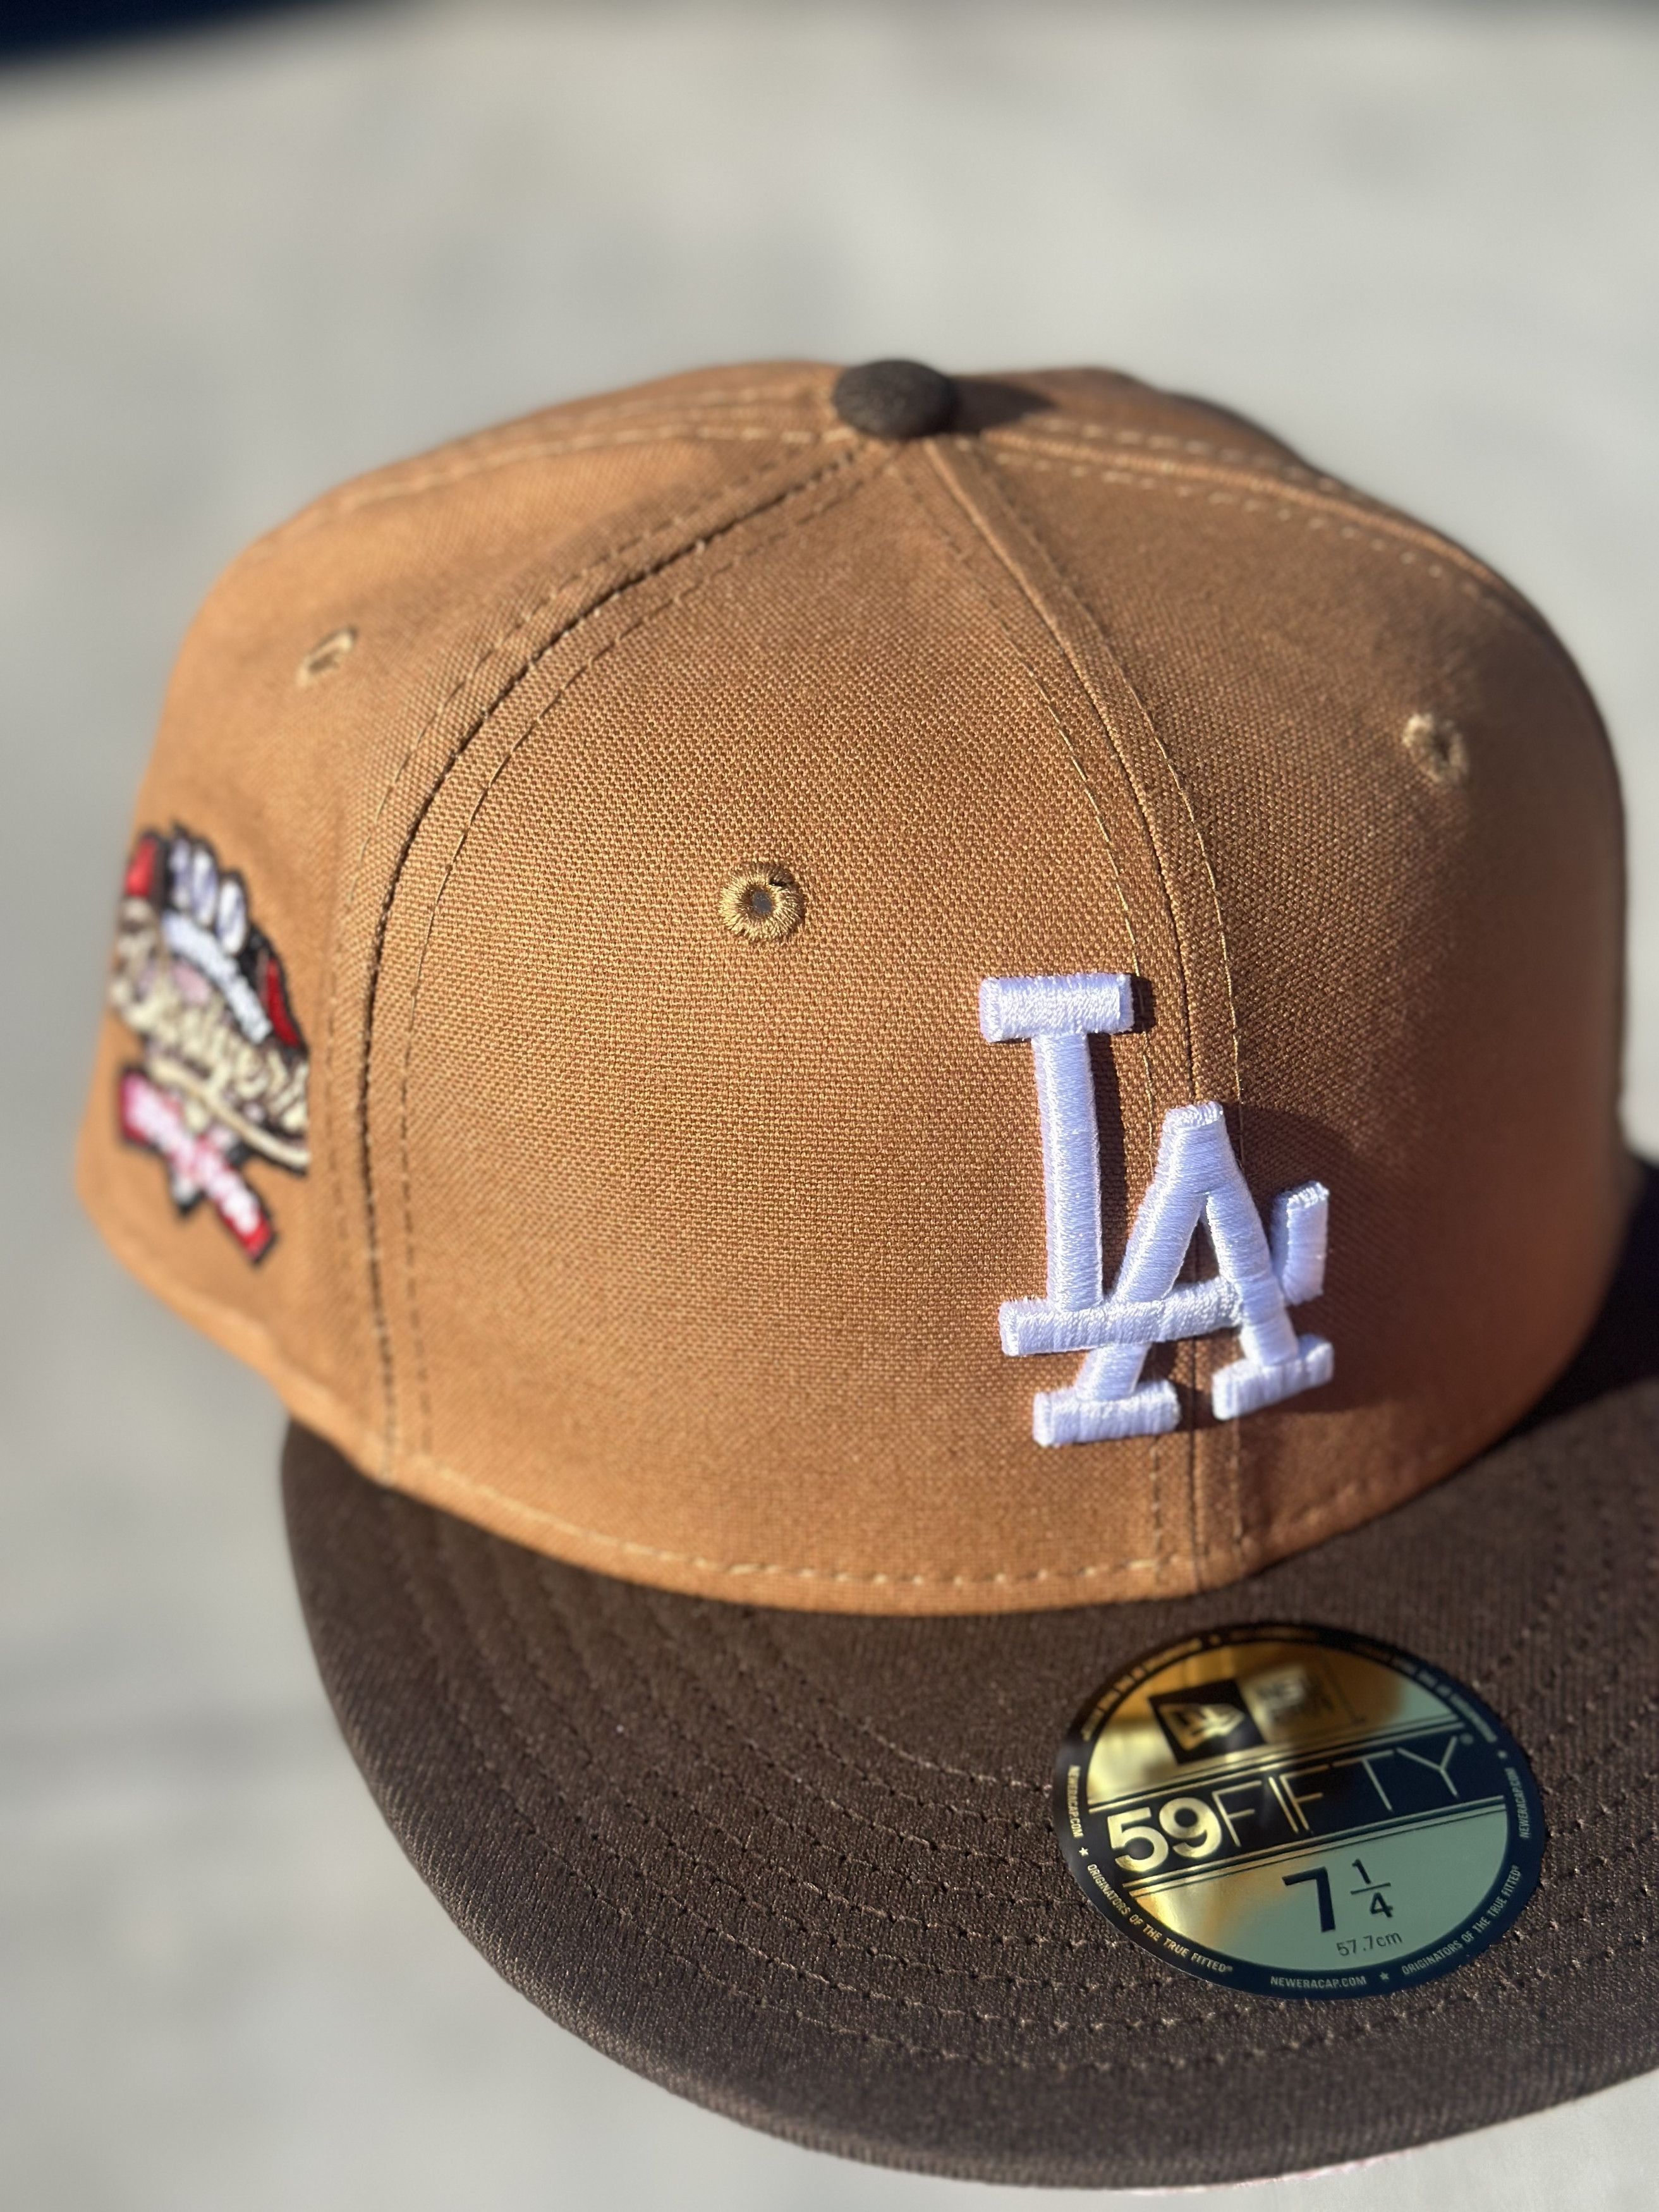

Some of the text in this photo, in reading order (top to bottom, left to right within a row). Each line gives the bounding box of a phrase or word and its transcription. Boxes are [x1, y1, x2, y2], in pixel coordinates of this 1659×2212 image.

[979, 971, 1335, 1449] LA
[1087, 1864, 1131, 1916] ORIGINATORS
[1129, 1914, 1144, 1926] OF
[1142, 1924, 1163, 1942] THE
[1162, 1937, 1189, 1957] TRUE
[1282, 1866, 1336, 1933] 7
[1336, 1932, 1402, 1957] 57.7cm
[1401, 1939, 1463, 1976] ORIGINATORS
[1461, 1929, 1474, 1943] OF
[1471, 1916, 1491, 1934] THE
[1487, 1899, 1507, 1917] TRUE
[1270, 1976, 1367, 1989] NEWERACAP.COM
